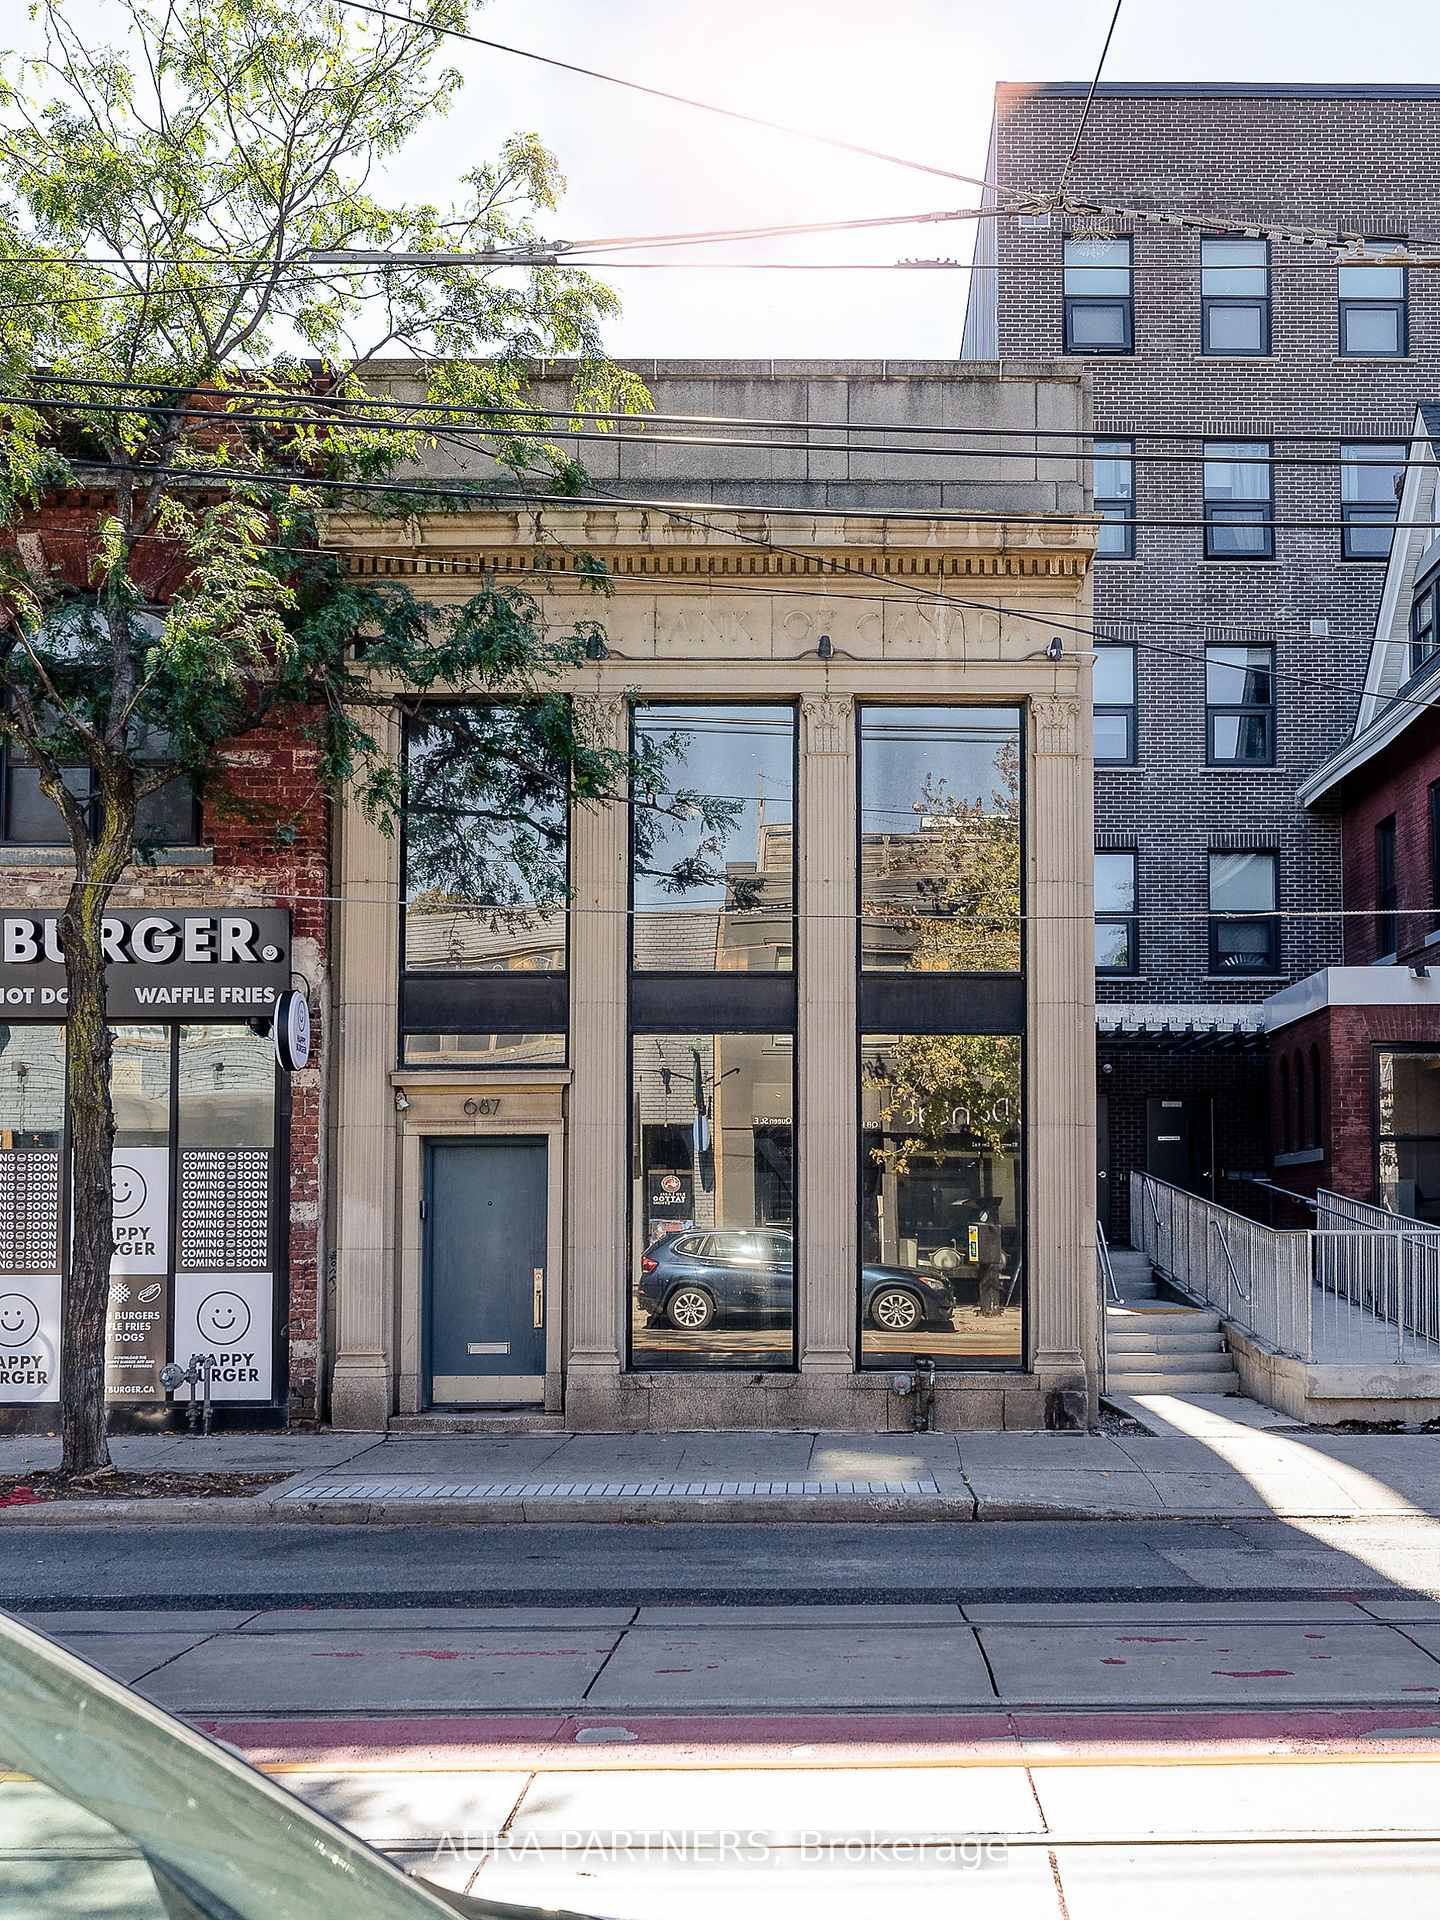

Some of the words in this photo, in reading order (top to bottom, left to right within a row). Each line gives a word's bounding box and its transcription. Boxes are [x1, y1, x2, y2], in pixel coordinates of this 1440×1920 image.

[135, 988, 214, 1004] WAFFLE
[220, 987, 275, 1004] FRIES
[463, 1097, 501, 1116] 687
[27, 1153, 59, 1162] SOON
[182, 1151, 226, 1161] COMING
[237, 1151, 269, 1161] SOON
[27, 1163, 58, 1172] SOON
[182, 1161, 226, 1170] COMING
[237, 1161, 269, 1170] SOON
[26, 1172, 58, 1182] SOON
[182, 1170, 226, 1180] COMING
[237, 1170, 268, 1180] SOON
[26, 1182, 58, 1191] SOON
[182, 1180, 226, 1190] COMING
[237, 1180, 268, 1190] SOON
[26, 1191, 58, 1201] SOON
[182, 1190, 226, 1199] COMING
[236, 1190, 268, 1199] SOON
[26, 1201, 58, 1211] SOON
[182, 1200, 226, 1209] COMING
[236, 1200, 268, 1209] SOON
[26, 1211, 58, 1221] SOON
[181, 1209, 226, 1219] COMING
[236, 1209, 268, 1219] SOON
[26, 1221, 57, 1230] SOON
[181, 1219, 226, 1229] COMING
[236, 1219, 268, 1229] SOON
[25, 1231, 57, 1240] SOON
[181, 1229, 225, 1238] COMING
[236, 1229, 268, 1238] SOON
[25, 1240, 57, 1250] SOON
[181, 1239, 225, 1248] COMING
[236, 1239, 267, 1248] SOON
[25, 1250, 57, 1260] SOON
[181, 1248, 225, 1258] COMING
[236, 1248, 267, 1258] SOON
[25, 1260, 57, 1269] SOON
[181, 1258, 225, 1267] COMING
[235, 1258, 267, 1267] SOON
[114, 1311, 161, 1321] BURGERS
[125, 1321, 152, 1332] FRIES
[114, 1333, 145, 1343] DOGS
[193, 1368, 260, 1382] URGER
